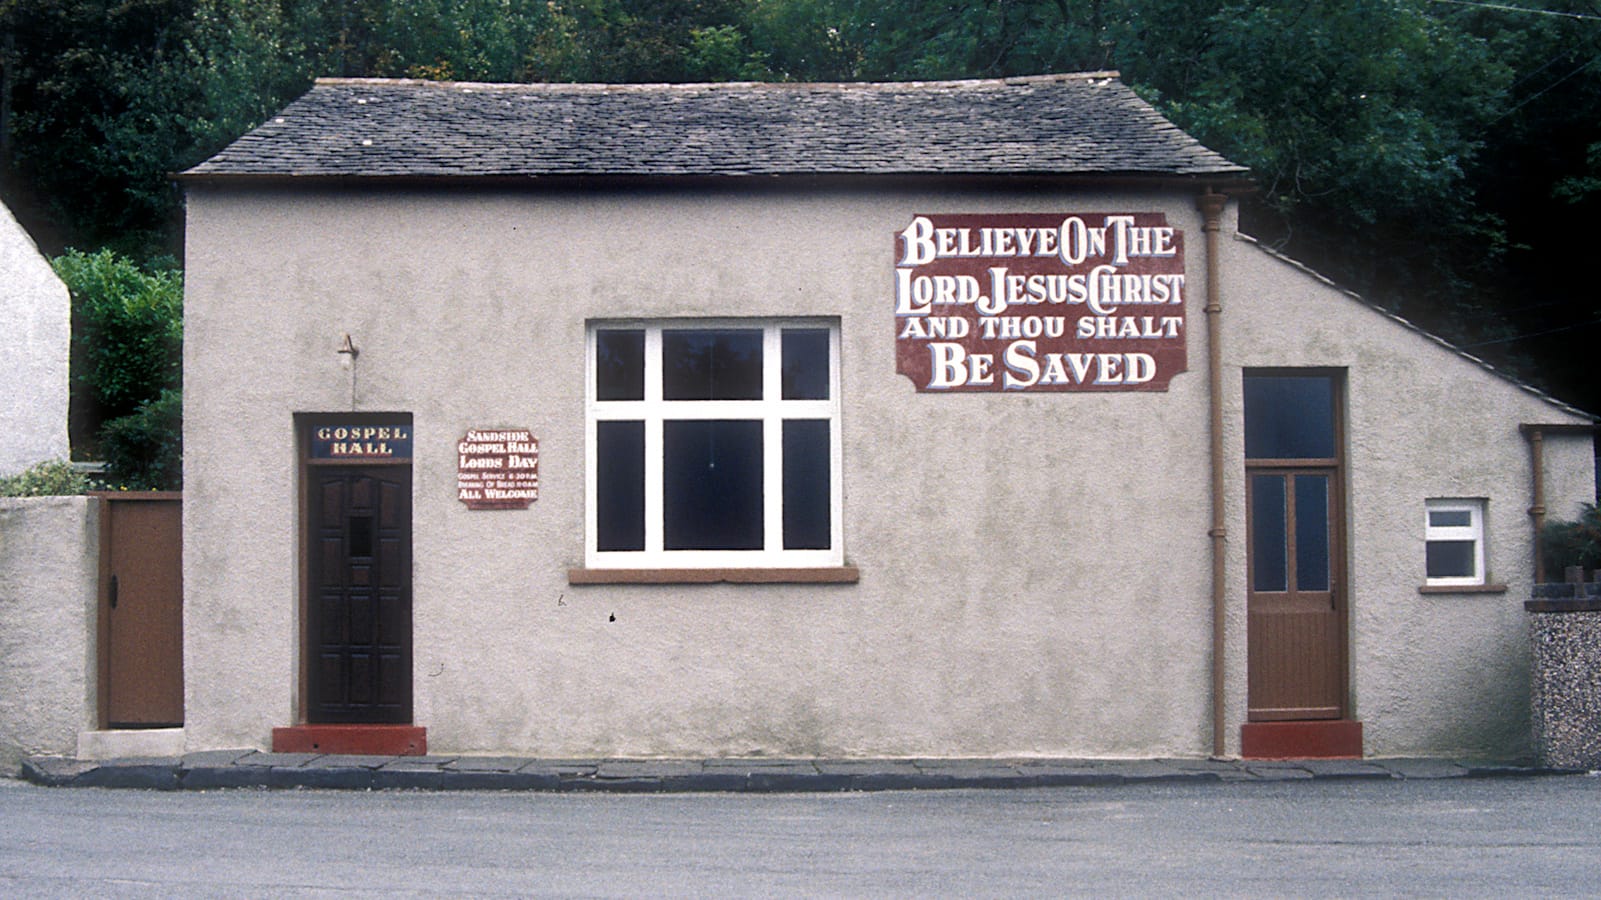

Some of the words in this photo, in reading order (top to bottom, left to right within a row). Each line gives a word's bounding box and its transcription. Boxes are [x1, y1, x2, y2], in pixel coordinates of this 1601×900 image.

[1059, 216, 1108, 266] ON
[1103, 215, 1176, 266] THE
[895, 268, 980, 316] LORD
[975, 267, 1088, 315] JESUS
[1086, 264, 1184, 315] CHRIST
[899, 317, 969, 339] AND
[979, 317, 1065, 339] THOU
[1076, 317, 1183, 339] SHALT
[926, 342, 994, 389] BE
[1002, 340, 1157, 390] SAVED
[317, 427, 408, 440] GOSPEL
[466, 430, 529, 442] SANDSIDE
[332, 442, 393, 455] HALL
[458, 442, 506, 454] GOSPEL
[507, 442, 538, 453] HALL
[459, 455, 503, 468] LORDS
[508, 455, 538, 468] DAY
[459, 489, 482, 499] ALL
[484, 489, 538, 499] WELCOME
